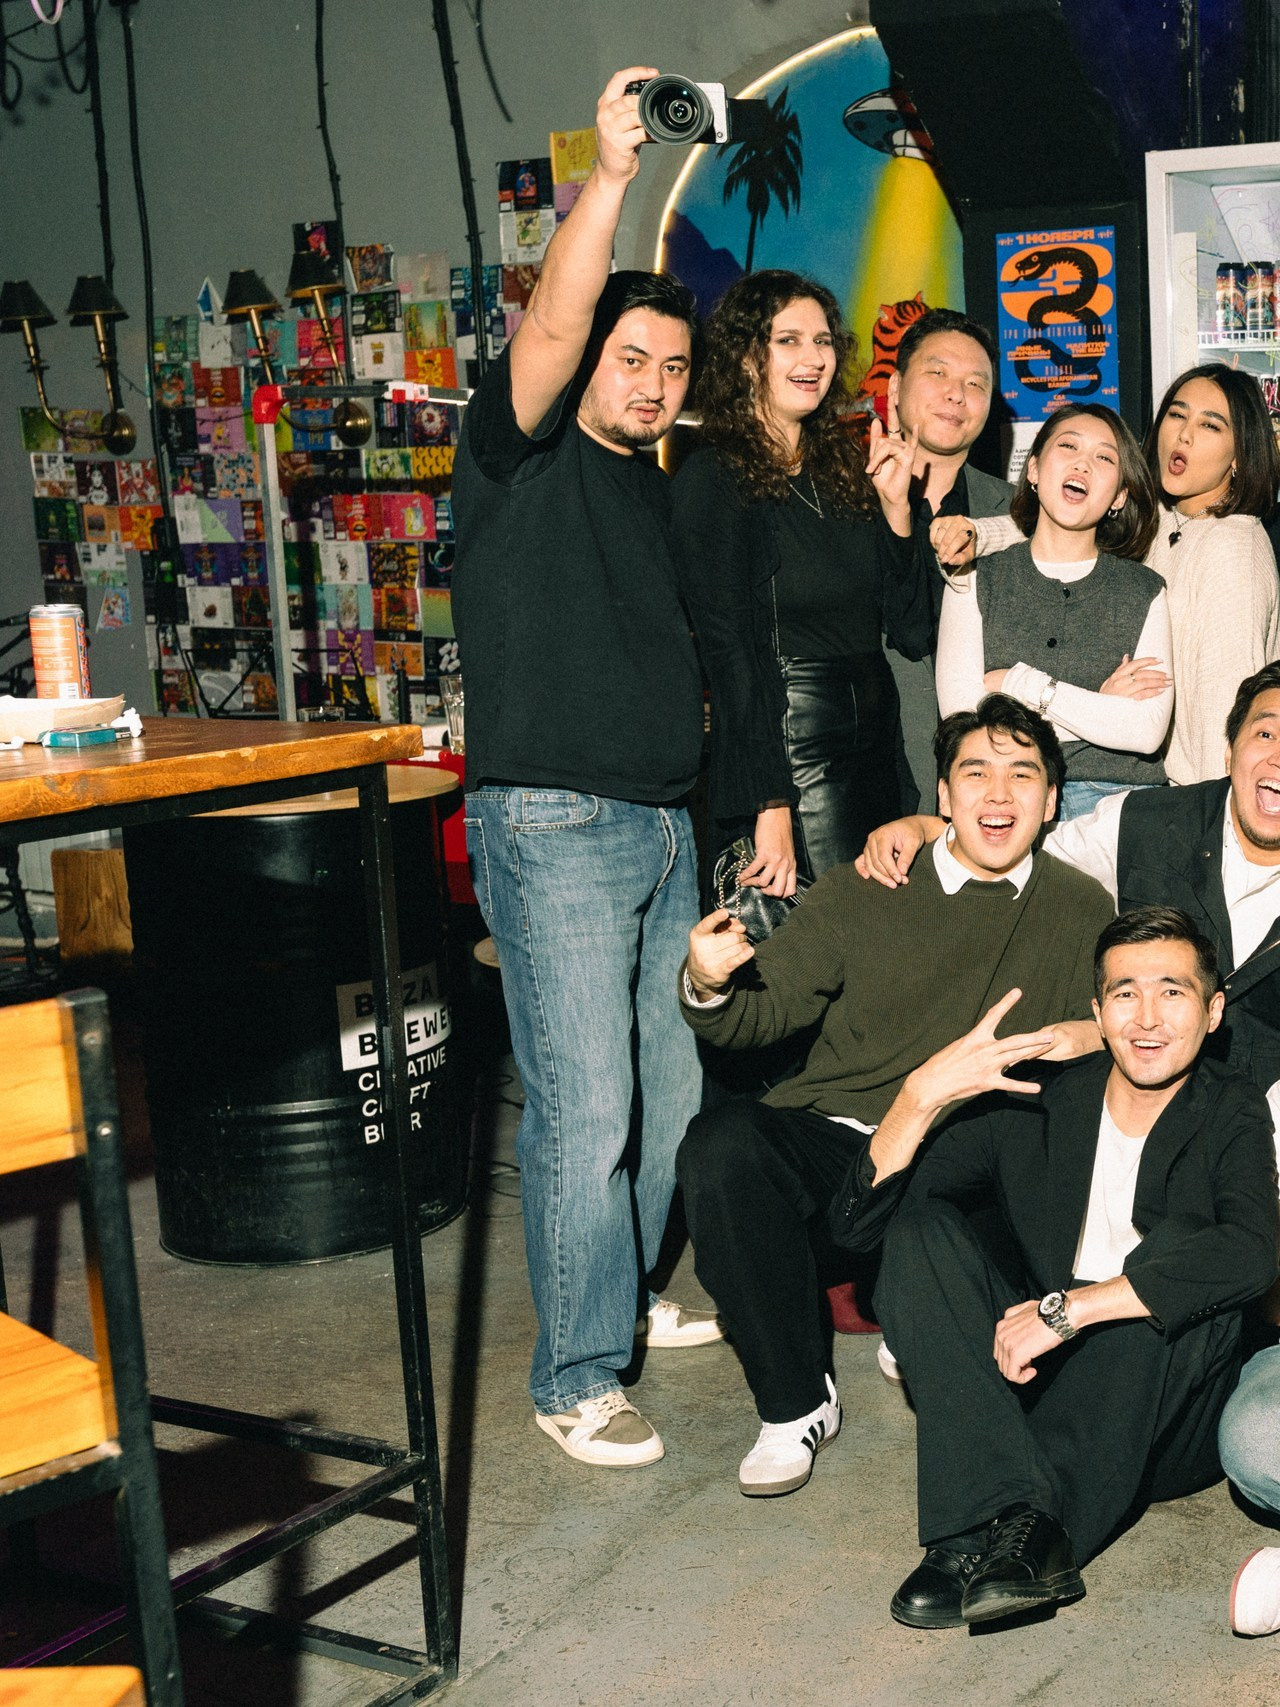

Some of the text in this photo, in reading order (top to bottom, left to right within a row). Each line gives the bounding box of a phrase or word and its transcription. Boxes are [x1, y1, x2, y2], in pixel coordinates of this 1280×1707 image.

[1026, 229, 1095, 245] НОЯБРЯ
[355, 976, 434, 1018] BZA
[358, 1046, 446, 1092] CATIVE
[362, 1081, 431, 1117] CFT
[364, 1111, 422, 1145] BR
